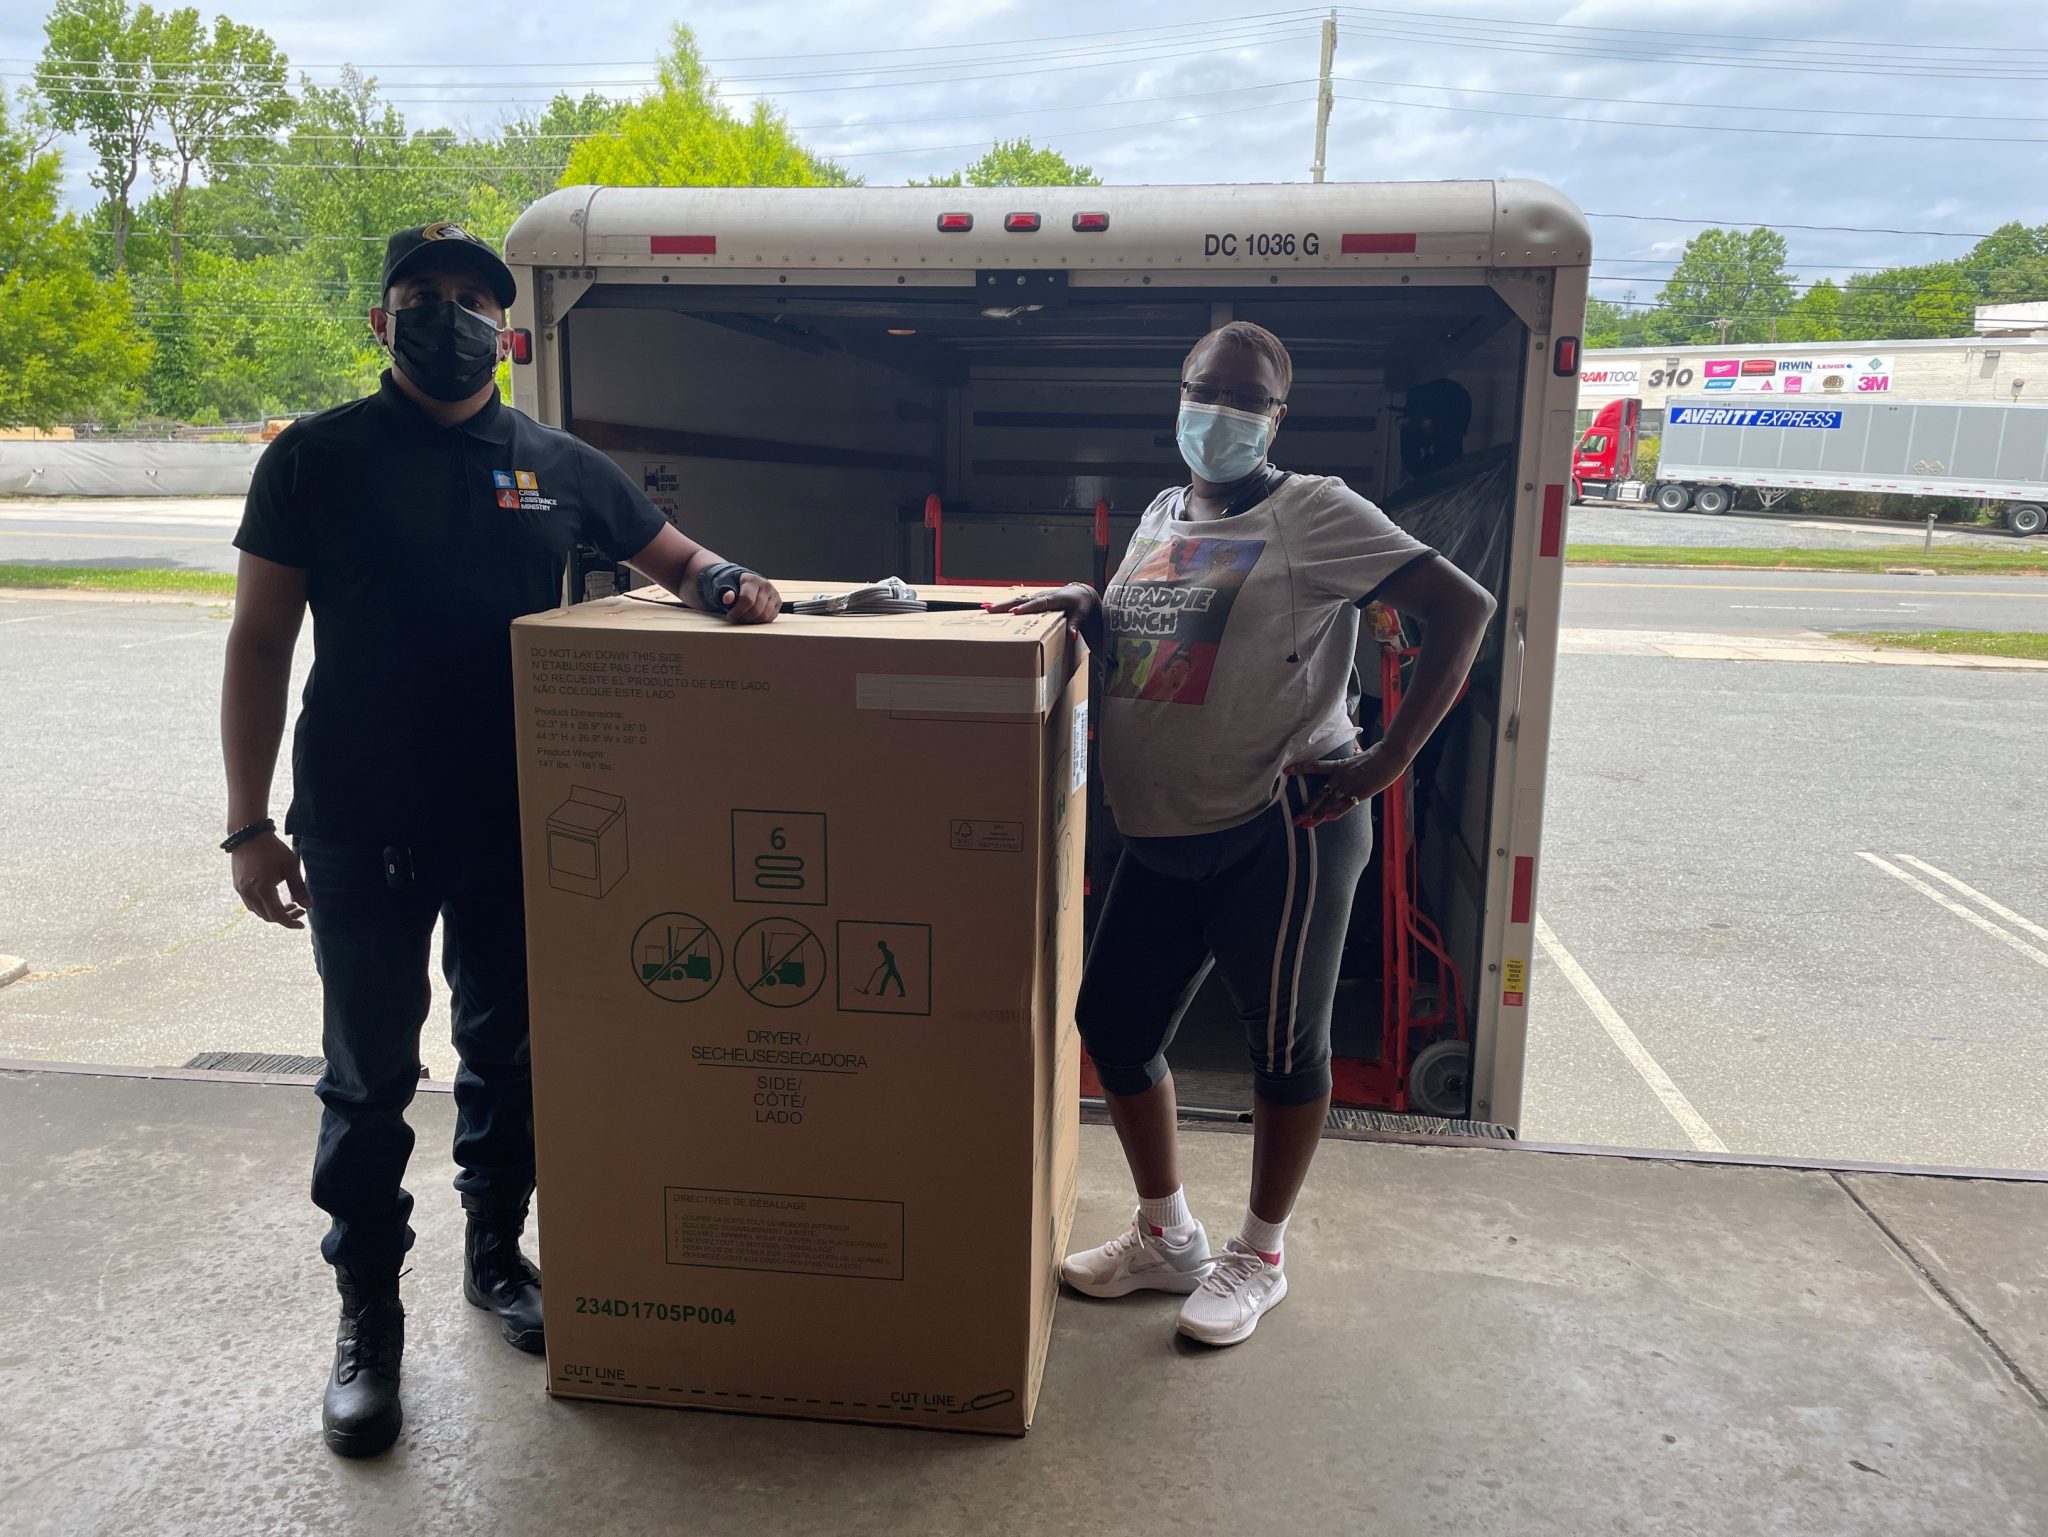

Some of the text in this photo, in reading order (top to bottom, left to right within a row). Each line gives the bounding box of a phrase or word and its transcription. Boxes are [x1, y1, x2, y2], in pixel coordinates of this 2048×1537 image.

[1205, 232, 1319, 256] DC 1036 G
[1778, 361, 1813, 370] IRWIN
[1609, 371, 1639, 382] TOOL
[1648, 368, 1694, 388] 310
[1858, 376, 1889, 391] 3M
[1676, 409, 1836, 427] AVERITT EXPRESS
[520, 497, 558, 506] ASSISTANCE
[1127, 586, 1216, 613] BADDIE
[1110, 608, 1179, 635] BUNCH
[532, 648, 683, 663] DO NOT LAY DOWN THIS SIDE
[610, 663, 631, 673] PAS
[634, 664, 649, 674] CE
[533, 674, 771, 691] NO RECUESTE EL PRODUCTO DE ESTE LADO
[533, 684, 675, 699] NÃO COLOQUE ESTE LADO
[535, 707, 623, 719] Product Dimensions:
[560, 721, 567, 729] H
[602, 722, 613, 731] W
[640, 724, 647, 732] D
[561, 733, 568, 741] H
[603, 735, 614, 743] W
[640, 736, 647, 745] D
[537, 747, 606, 759] Product Weight:
[539, 760, 553, 768] 147
[771, 826, 787, 851] 6
[747, 1030, 811, 1046] DRYER /
[691, 1046, 868, 1069] SECHEUSE/SECADORA
[757, 1076, 803, 1091] SIDE/
[753, 1091, 807, 1108] CÔTÉ/
[755, 1109, 803, 1125] LADO
[673, 1194, 807, 1211] DIRECTIVES DE DÉBALLAGE
[575, 1296, 737, 1326] 234D1705P004
[563, 1364, 625, 1381] CUT LINE
[890, 1391, 956, 1407] CUT LINE
